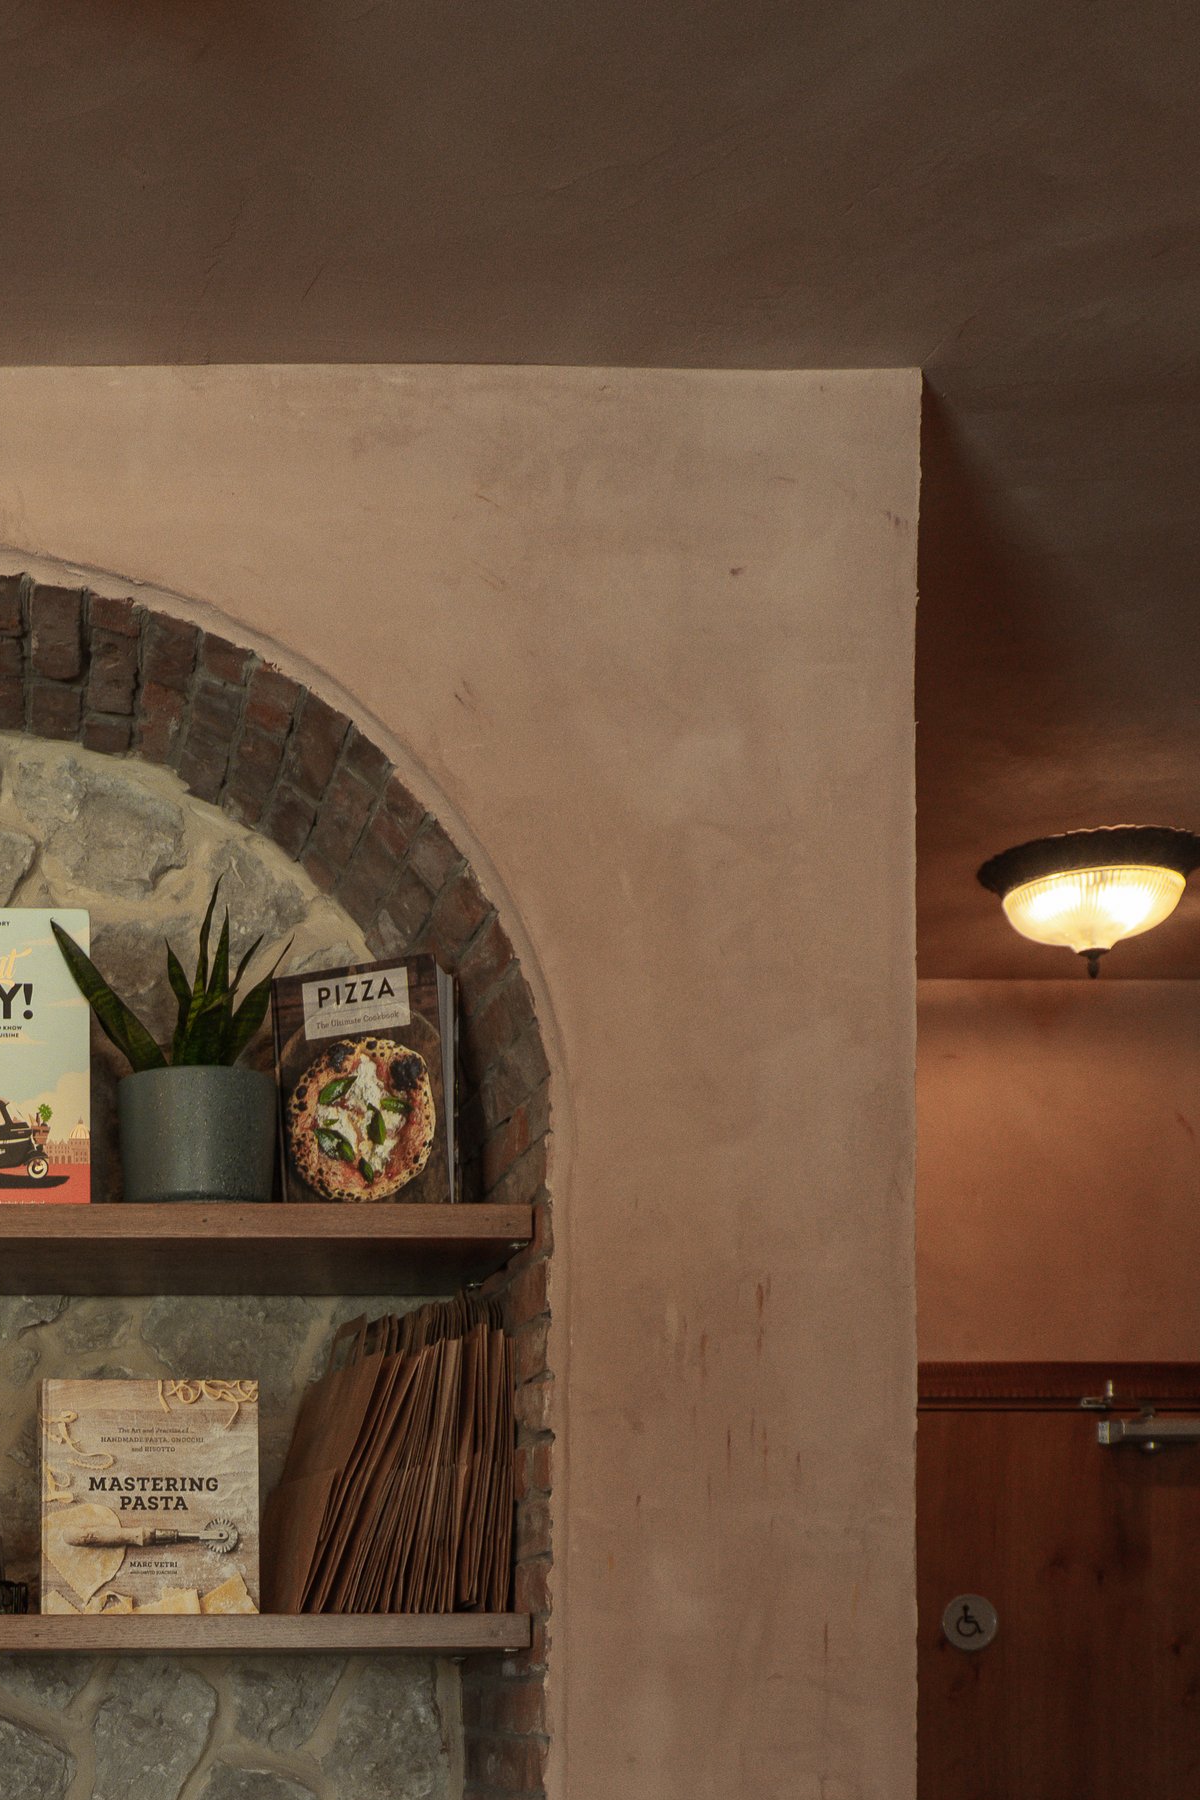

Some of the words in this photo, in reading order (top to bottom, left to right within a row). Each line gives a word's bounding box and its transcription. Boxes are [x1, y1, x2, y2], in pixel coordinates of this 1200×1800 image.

[317, 976, 395, 1009] PIZZA
[331, 1017, 361, 1027] Ultimate
[363, 1010, 399, 1022] Cookbook
[88, 1476, 219, 1492] MASTERING
[120, 1496, 189, 1511] PASTA
